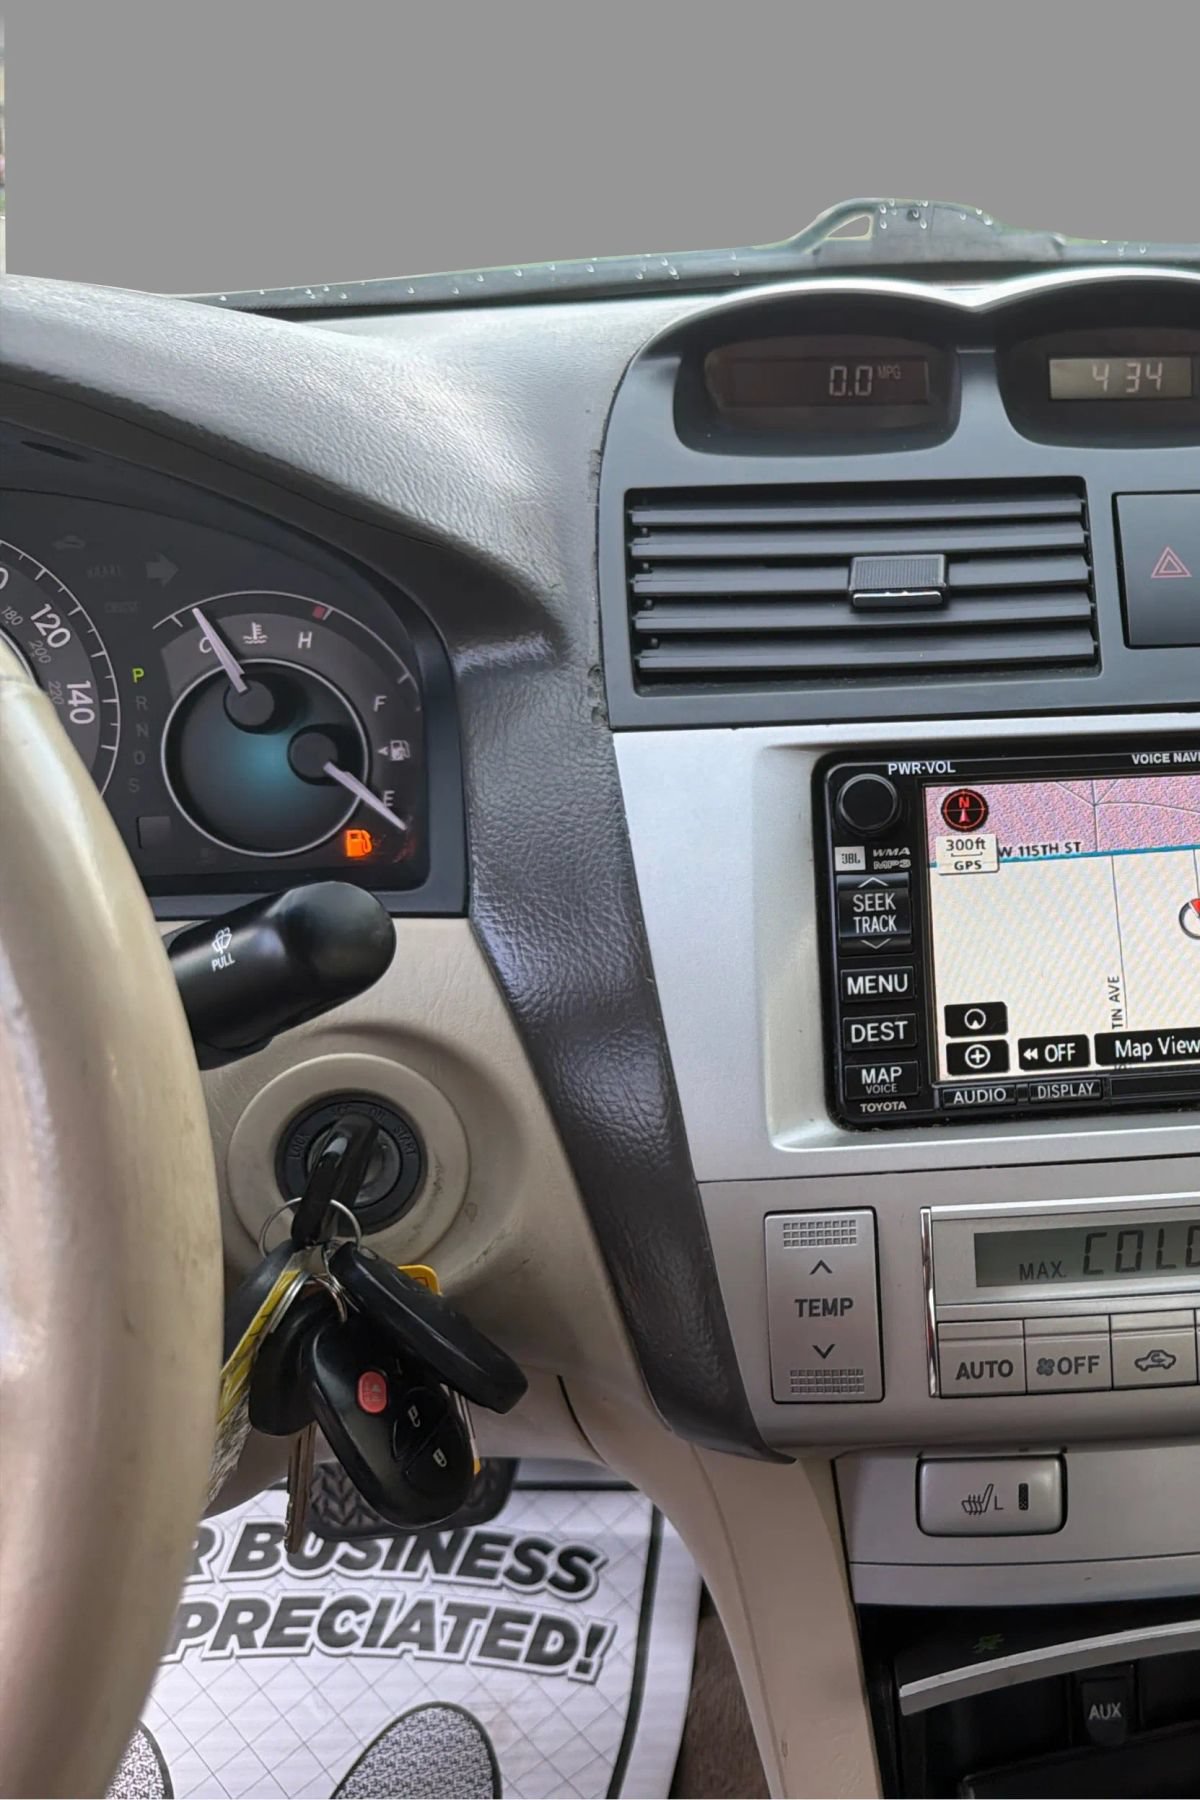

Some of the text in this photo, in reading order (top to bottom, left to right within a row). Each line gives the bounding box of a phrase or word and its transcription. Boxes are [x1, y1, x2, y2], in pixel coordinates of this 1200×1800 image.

[828, 364, 902, 396] 0.0 MPG
[1, 606, 23, 626] 180
[30, 603, 71, 648] 120
[297, 631, 313, 649] H
[29, 640, 52, 664] 200
[132, 668, 145, 684] P
[66, 680, 95, 724] 140
[373, 695, 388, 713] F
[1132, 752, 1171, 765] VOICE
[383, 790, 396, 808] E
[958, 797, 970, 809] N
[841, 853, 861, 864] JBL
[873, 847, 911, 857] WMA
[1000, 840, 1082, 858] W 115TH ST
[873, 859, 912, 870] MP3
[954, 860, 983, 871] GPS
[852, 893, 897, 912] SEEK
[853, 915, 897, 933] TRACK
[211, 952, 236, 973] PULL
[846, 972, 910, 996] MENU
[1107, 975, 1120, 1002] AVE
[850, 1020, 909, 1044] DEST
[1044, 1043, 1077, 1062] OFF
[1115, 1039, 1153, 1061] Map
[861, 1066, 902, 1085] MAP
[865, 1083, 898, 1094] VOICE
[953, 1088, 1007, 1105] AUDIO
[1037, 1082, 1095, 1099] DISPLAY
[860, 1099, 907, 1113] TOYOTA
[794, 1296, 854, 1317] TEMP
[955, 1359, 1014, 1381] AUTO
[1057, 1355, 1100, 1376] OFF
[993, 1494, 1004, 1511] L
[226, 1520, 602, 1595] BUSINESS
[162, 1595, 606, 1675] PRECIATED!
[1088, 1702, 1123, 1722] AUX
